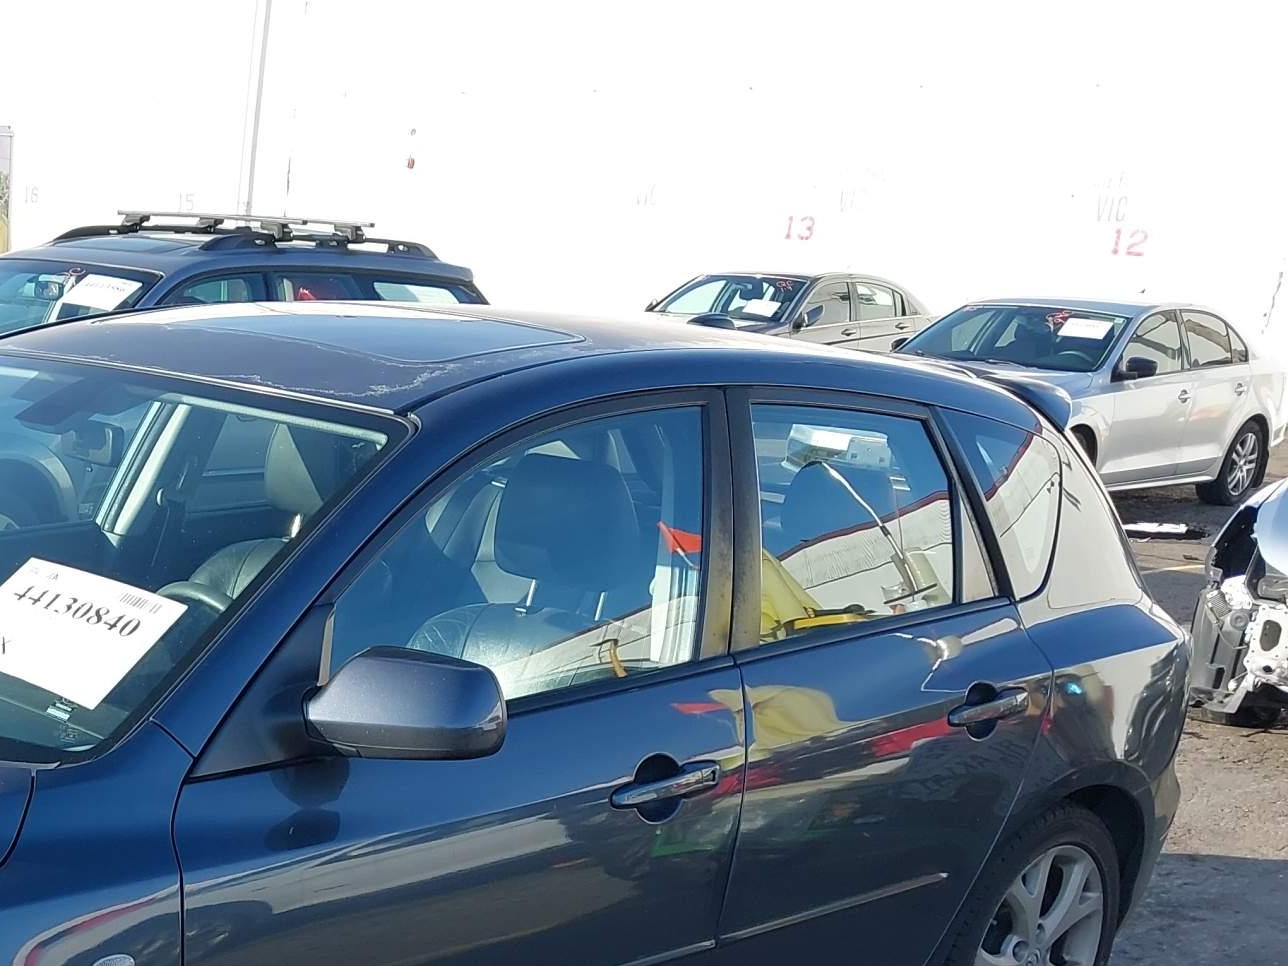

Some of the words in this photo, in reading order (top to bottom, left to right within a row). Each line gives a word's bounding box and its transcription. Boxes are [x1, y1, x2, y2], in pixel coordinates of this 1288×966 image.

[783, 215, 817, 241] 13
[1111, 228, 1149, 257] 12
[13, 585, 142, 638] 44130840
